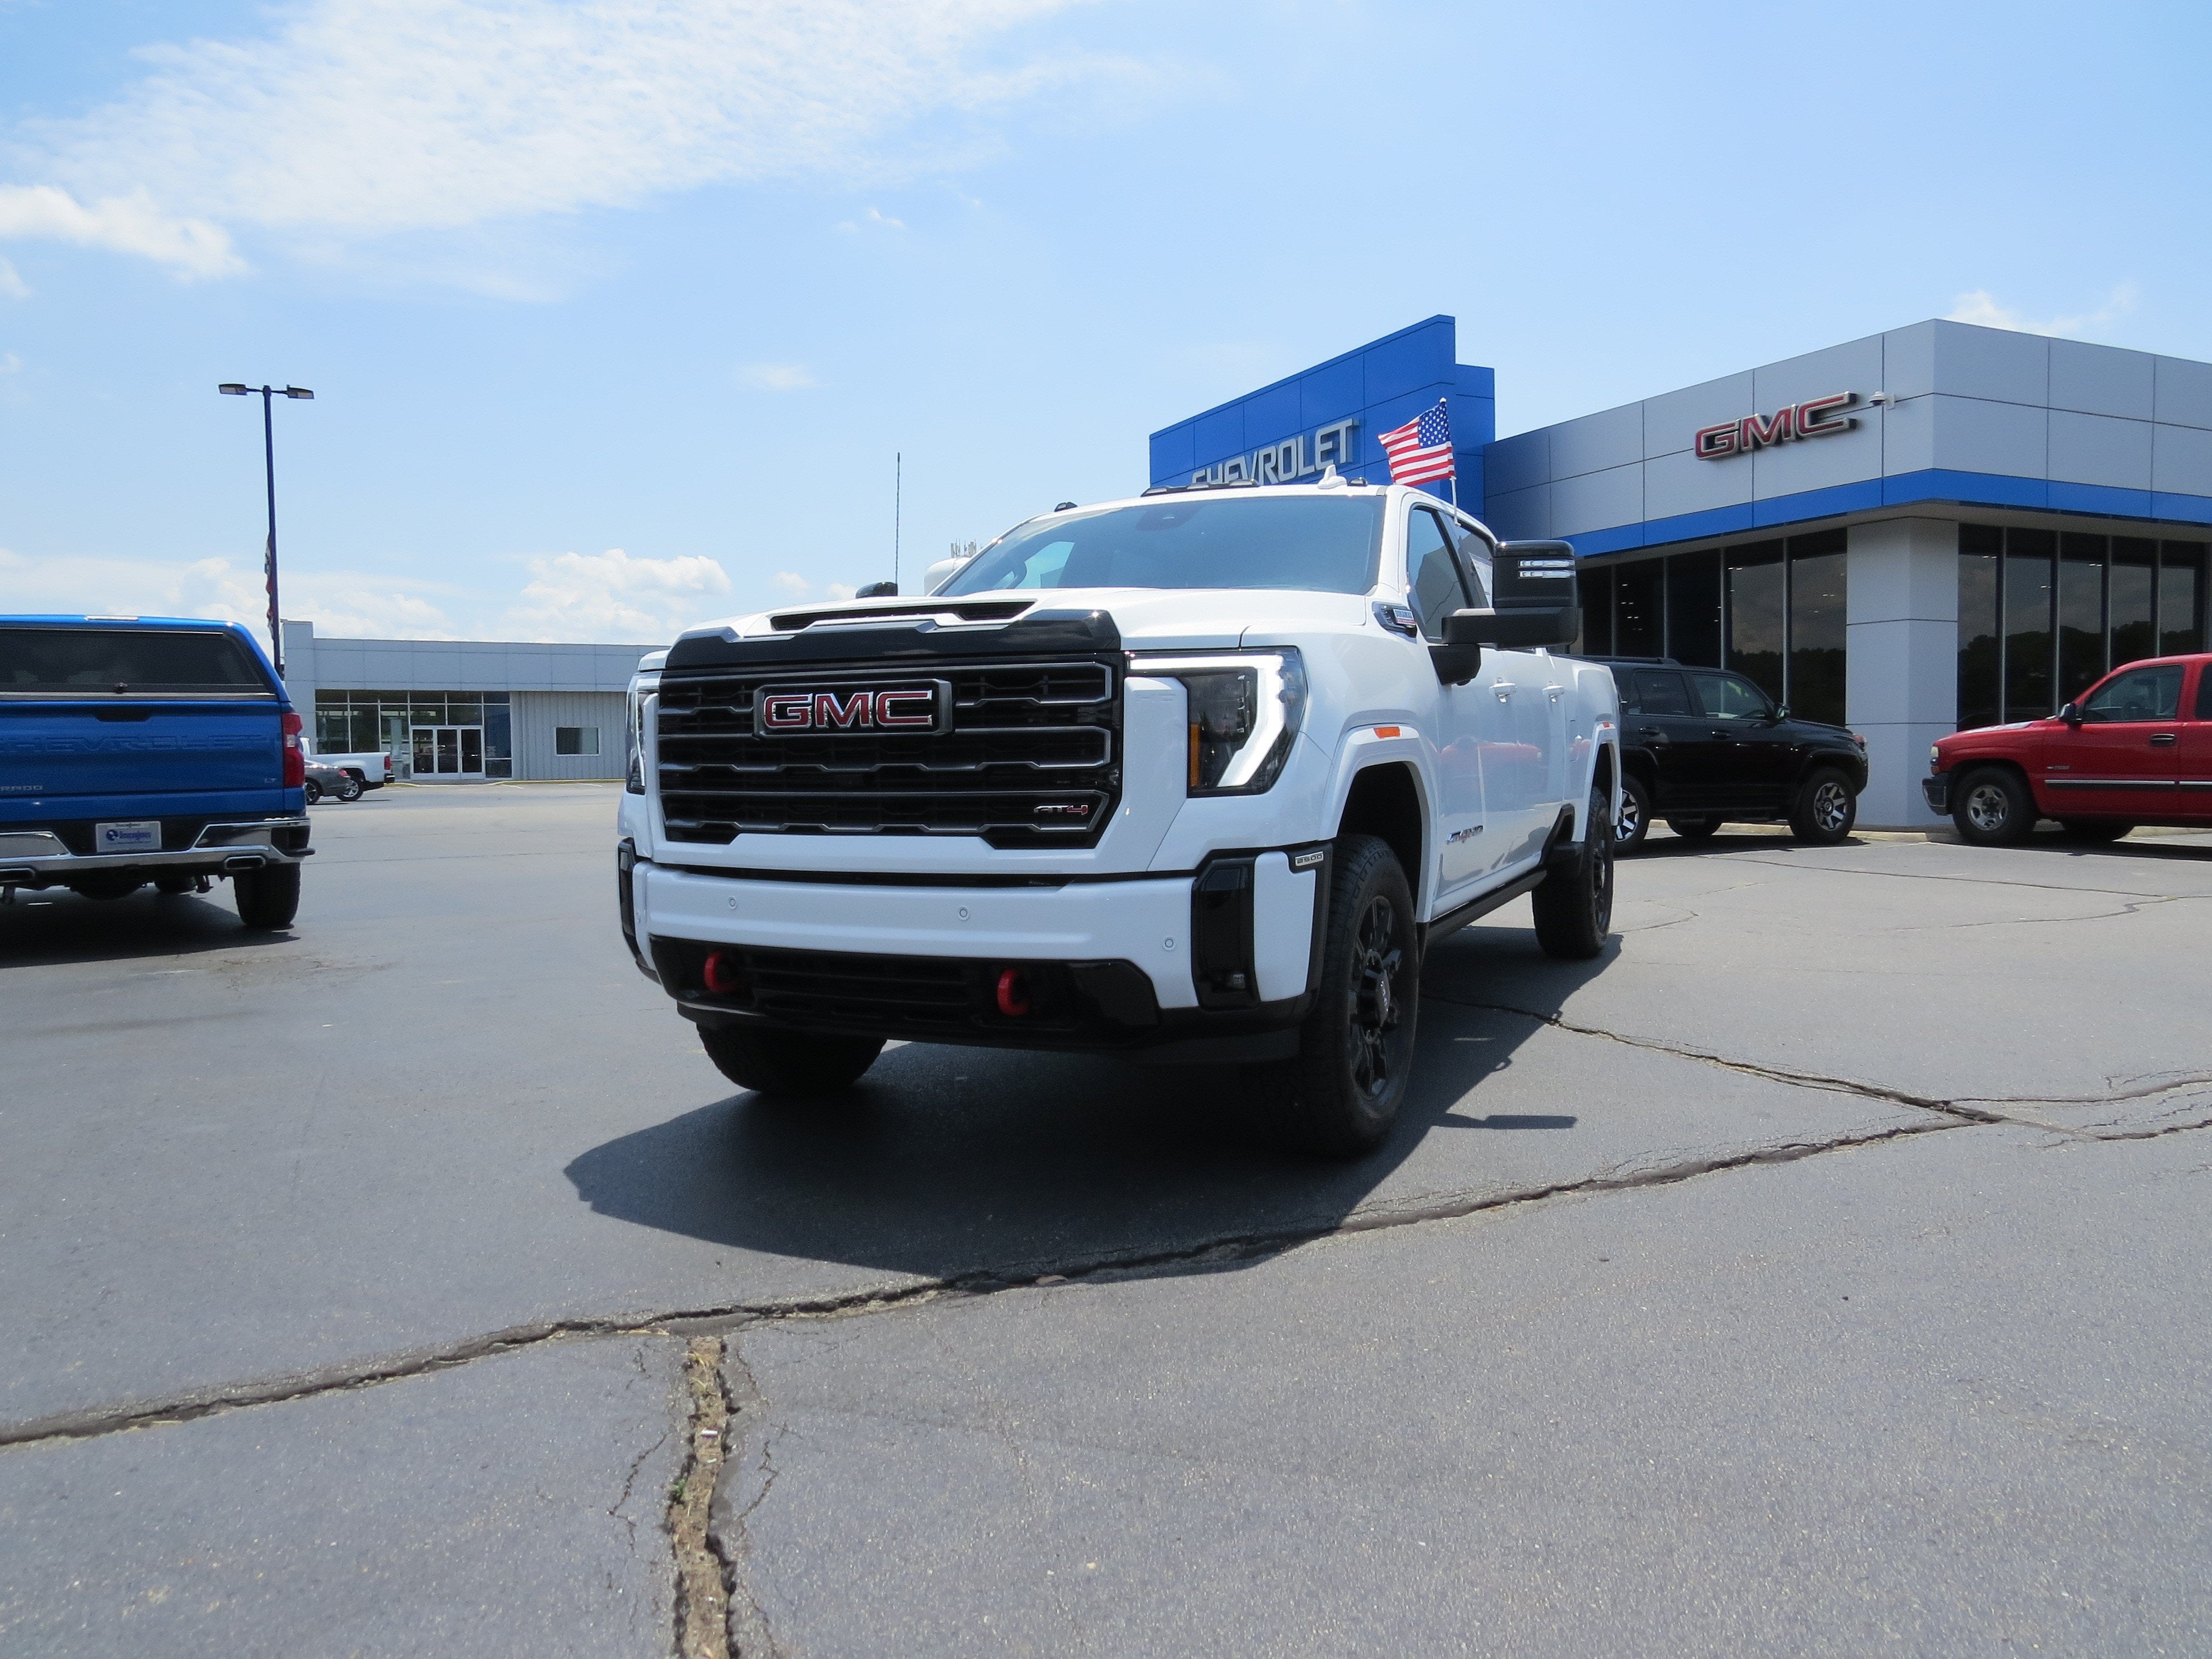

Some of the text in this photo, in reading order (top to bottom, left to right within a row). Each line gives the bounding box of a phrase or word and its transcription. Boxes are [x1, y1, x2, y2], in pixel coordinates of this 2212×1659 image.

[1694, 390, 1857, 460] GMC
[764, 690, 933, 728] GMC
[0, 734, 269, 753] HEVROLET
[1033, 805, 1088, 816] AT4
[1297, 853, 1322, 864] 2500
